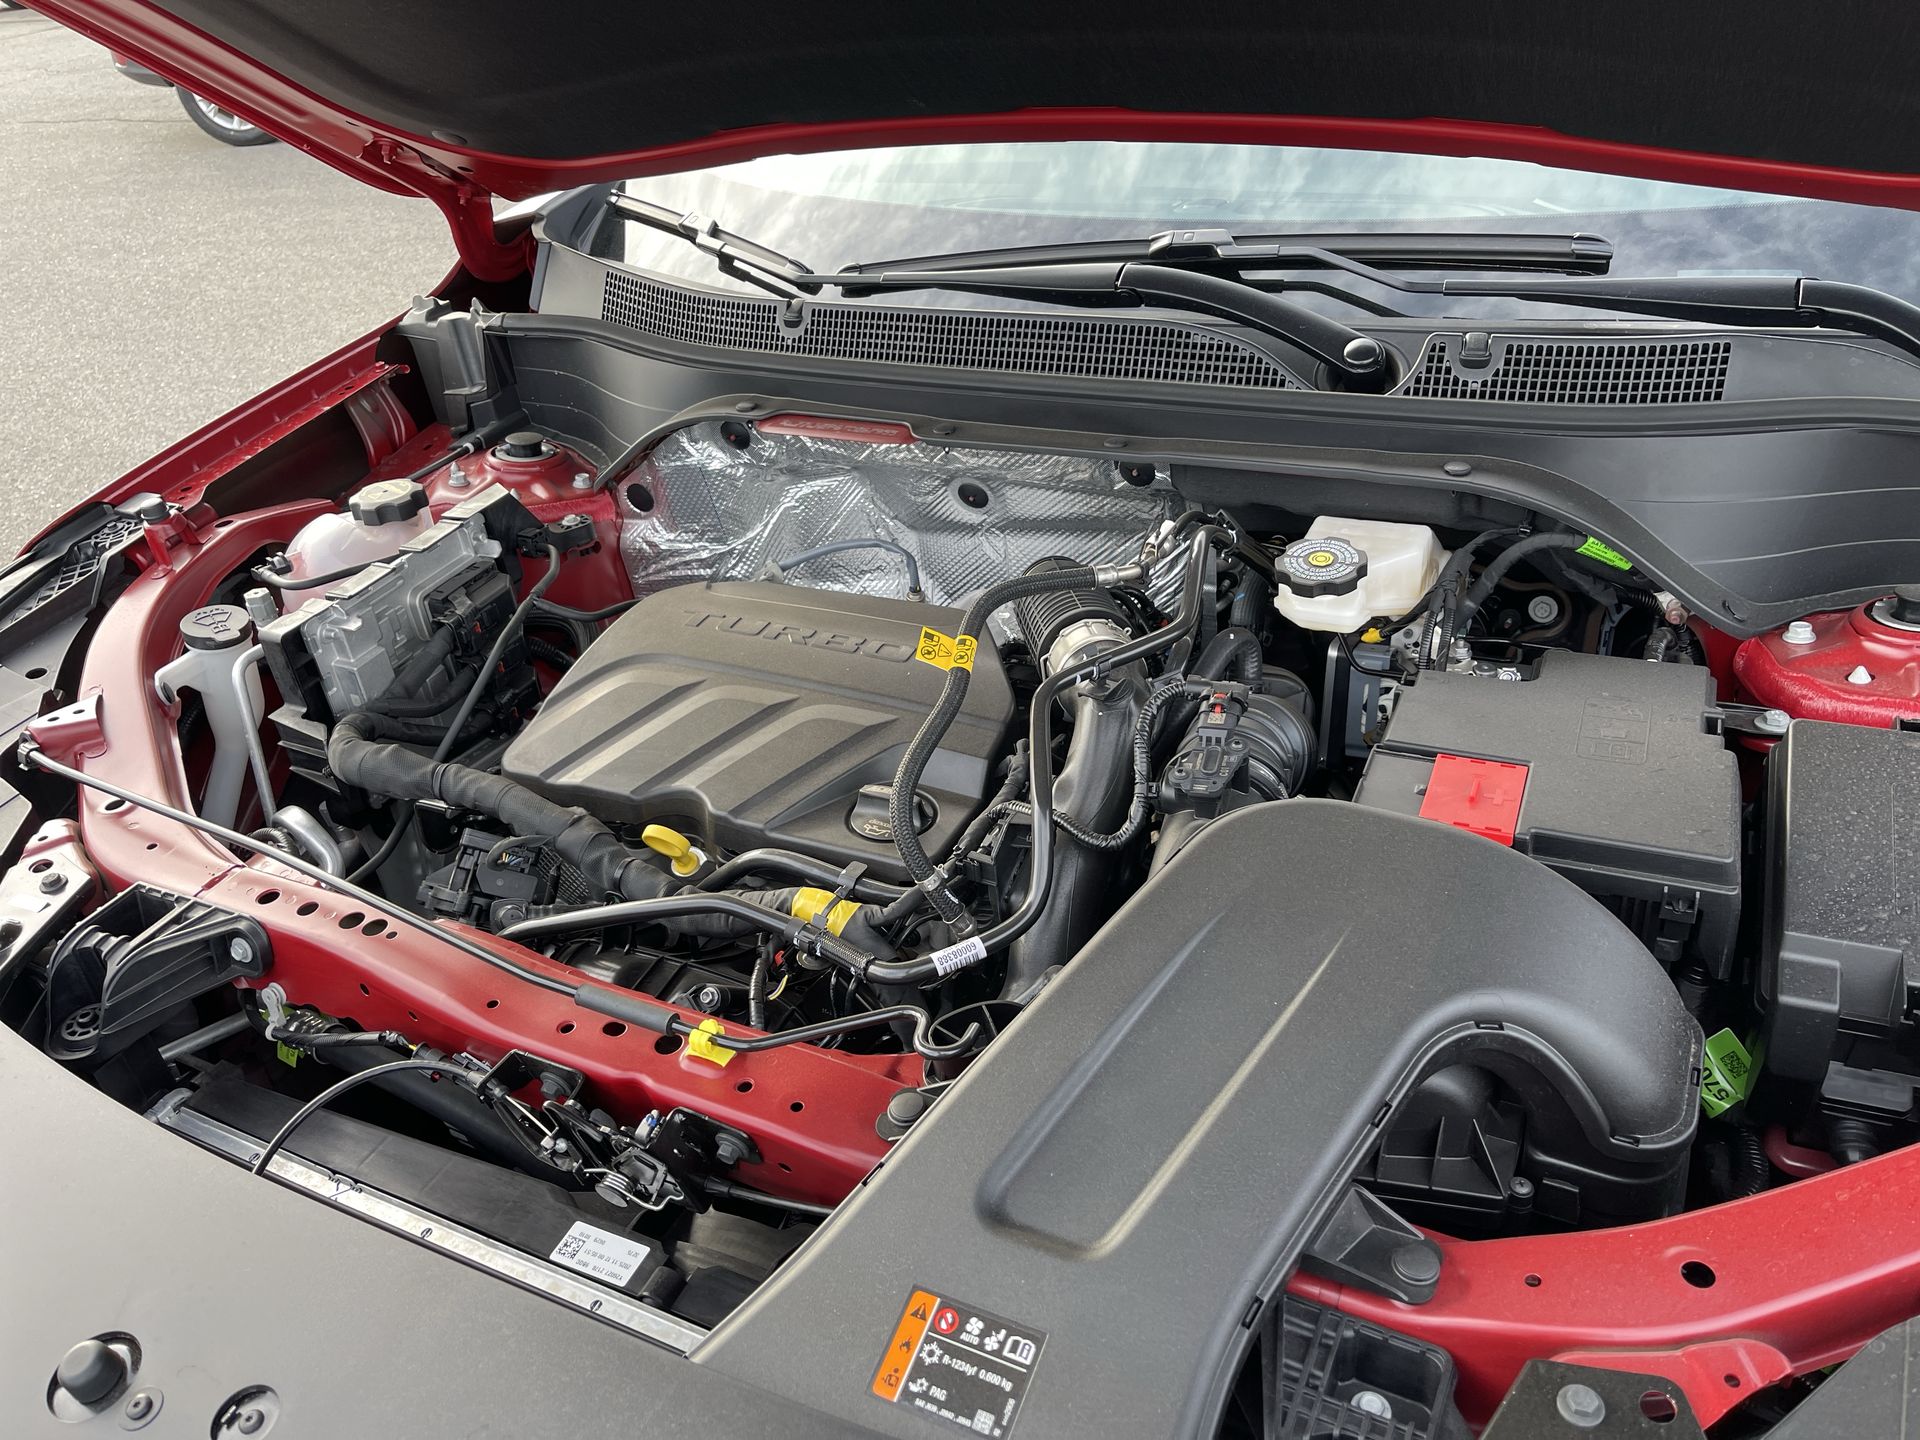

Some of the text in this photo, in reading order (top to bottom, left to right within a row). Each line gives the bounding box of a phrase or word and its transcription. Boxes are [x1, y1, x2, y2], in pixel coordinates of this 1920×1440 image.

[682, 608, 918, 664] TURBO
[960, 1331, 980, 1346] AUTO
[942, 1354, 1014, 1392] R-1234yf 0.600 kg
[929, 1385, 946, 1401] PAG
